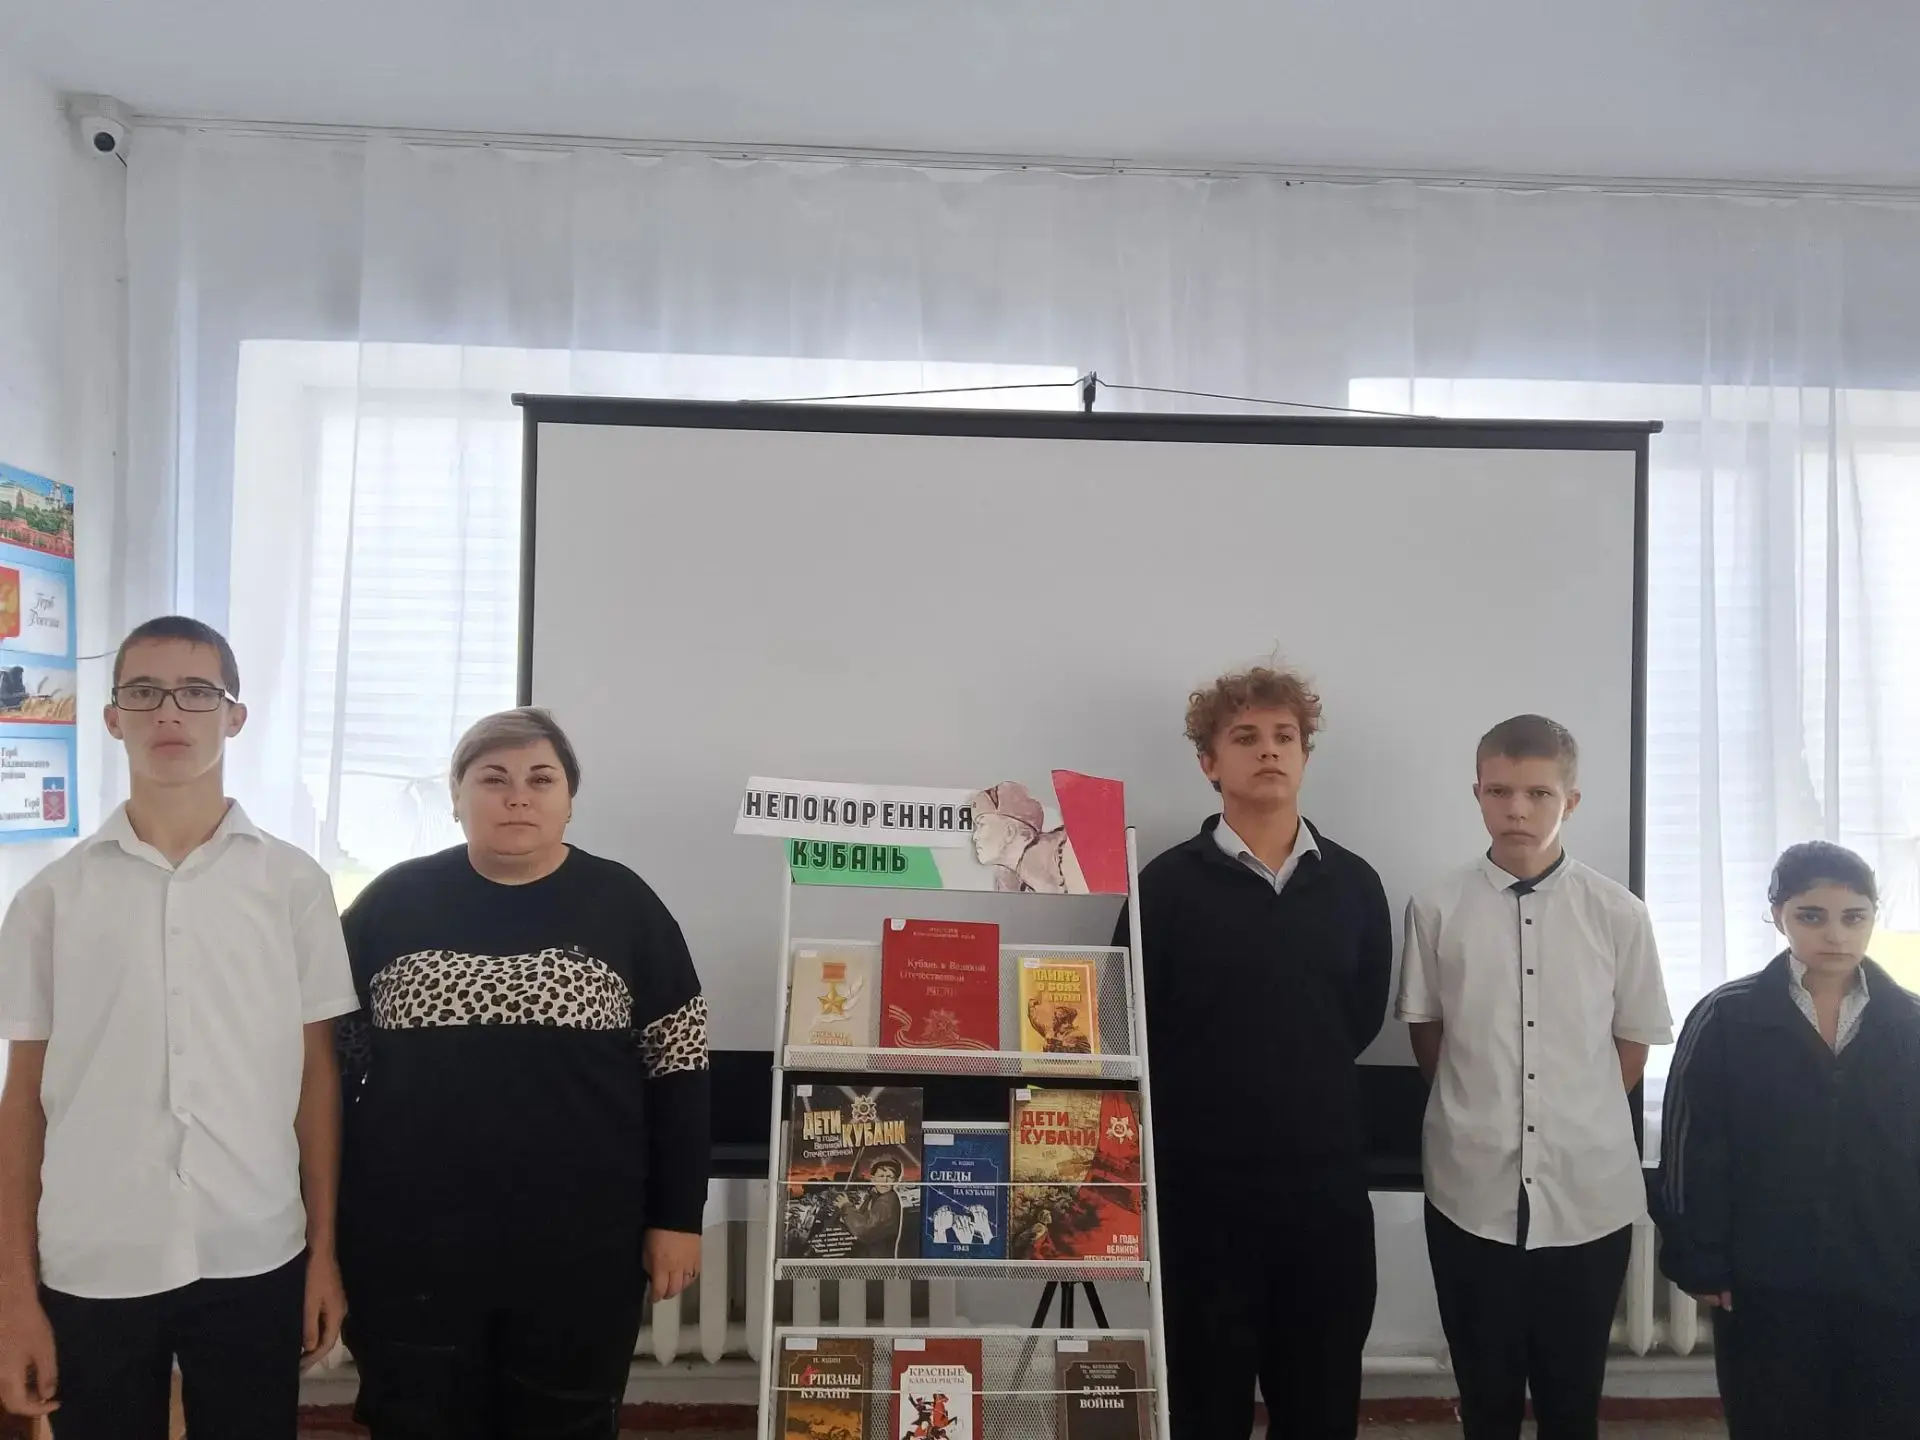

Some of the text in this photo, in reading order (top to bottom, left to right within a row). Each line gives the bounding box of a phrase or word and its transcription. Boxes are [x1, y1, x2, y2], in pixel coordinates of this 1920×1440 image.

[745, 789, 973, 832] НЕПОКОРЕННАЯ
[792, 838, 908, 873] КУБАНЬ
[803, 1110, 841, 1140] ДЕТИ
[1020, 1110, 1070, 1127] ДЕТИ
[842, 1119, 906, 1148] КУБАНИ
[1020, 1129, 1096, 1146] КУБАНИ
[930, 1170, 972, 1183] СЛЕДЫ
[1112, 1234, 1118, 1244] В
[1106, 1244, 1139, 1255] ВЕЛИКОЙ
[908, 1367, 965, 1377] КРАСНЫЕ
[1079, 1396, 1125, 1409] ВОЙНЫ
